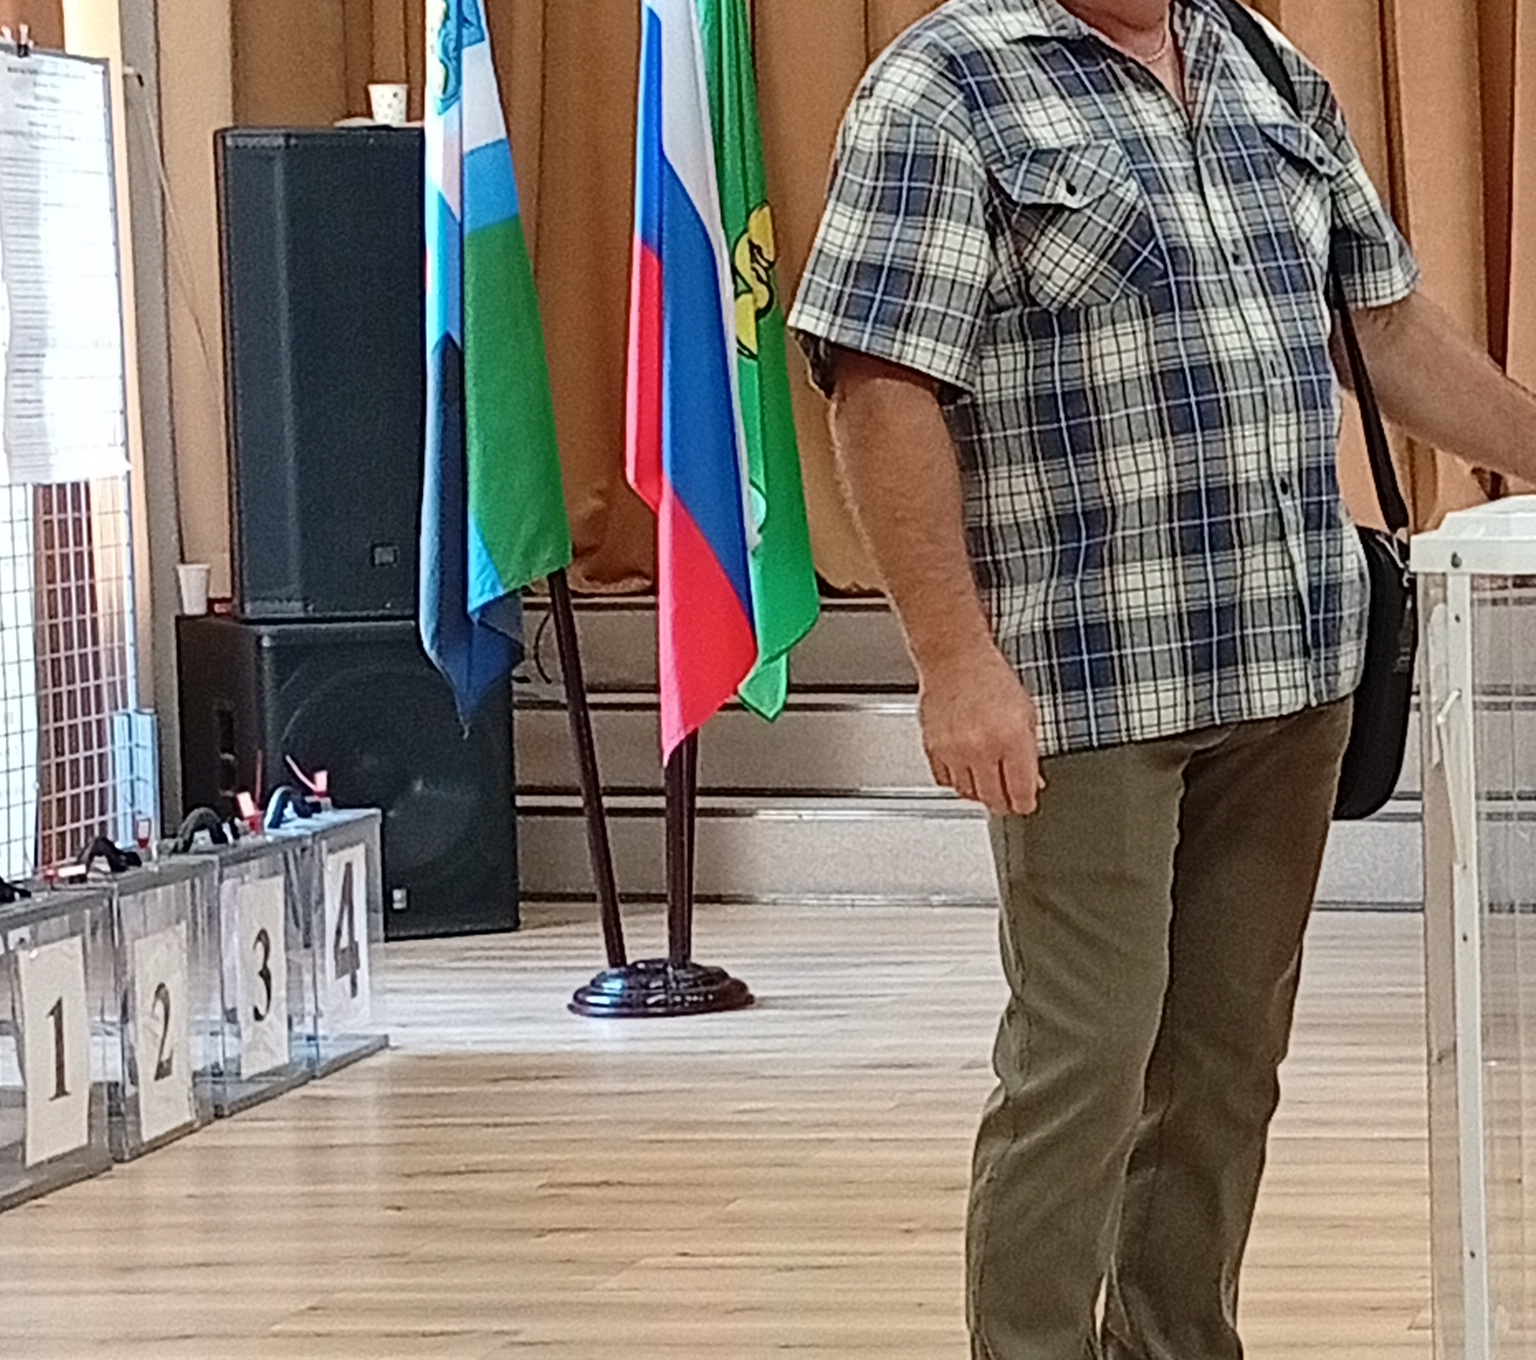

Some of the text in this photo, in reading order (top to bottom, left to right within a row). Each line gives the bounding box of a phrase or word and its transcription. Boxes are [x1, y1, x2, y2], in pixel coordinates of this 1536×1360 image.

[252, 927, 272, 1022] 3
[333, 861, 361, 1000] 4
[46, 996, 71, 1102] 1
[151, 982, 173, 1083] 2
